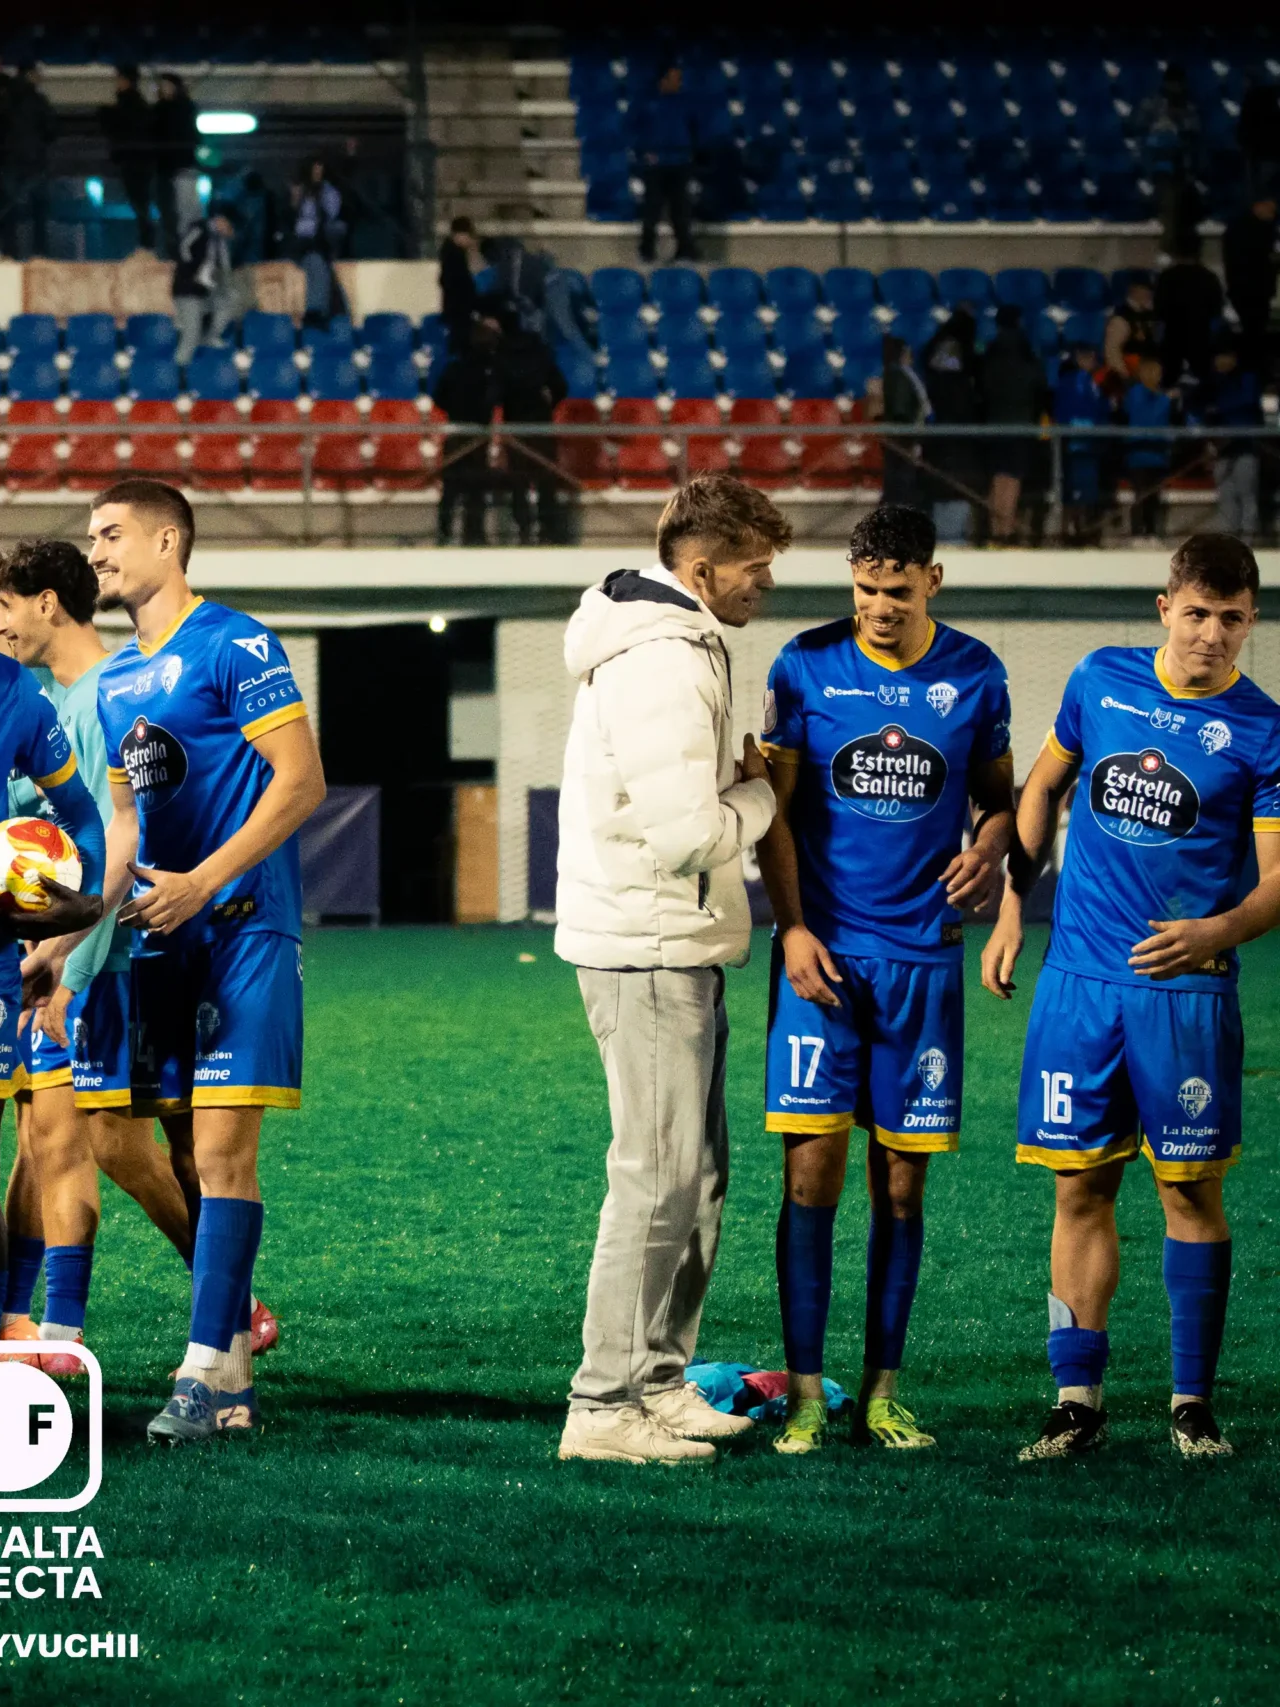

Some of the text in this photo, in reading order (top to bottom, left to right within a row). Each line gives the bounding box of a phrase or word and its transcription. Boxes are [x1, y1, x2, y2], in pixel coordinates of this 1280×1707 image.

[122, 741, 168, 771] Estrella
[850, 749, 932, 776] Estrella
[852, 771, 926, 798] Galicia
[1103, 764, 1183, 807] Estrella
[875, 798, 901, 816] 0,0
[1102, 787, 1173, 827] Galicia
[1118, 818, 1144, 838] 0,0
[787, 1034, 825, 1088] 17
[74, 1074, 103, 1087] time
[193, 1067, 231, 1081] ntime
[1040, 1070, 1073, 1124] 16
[903, 1113, 957, 1128] Ontime
[1162, 1125, 1179, 1135] La
[1161, 1141, 1217, 1156] Ontime
